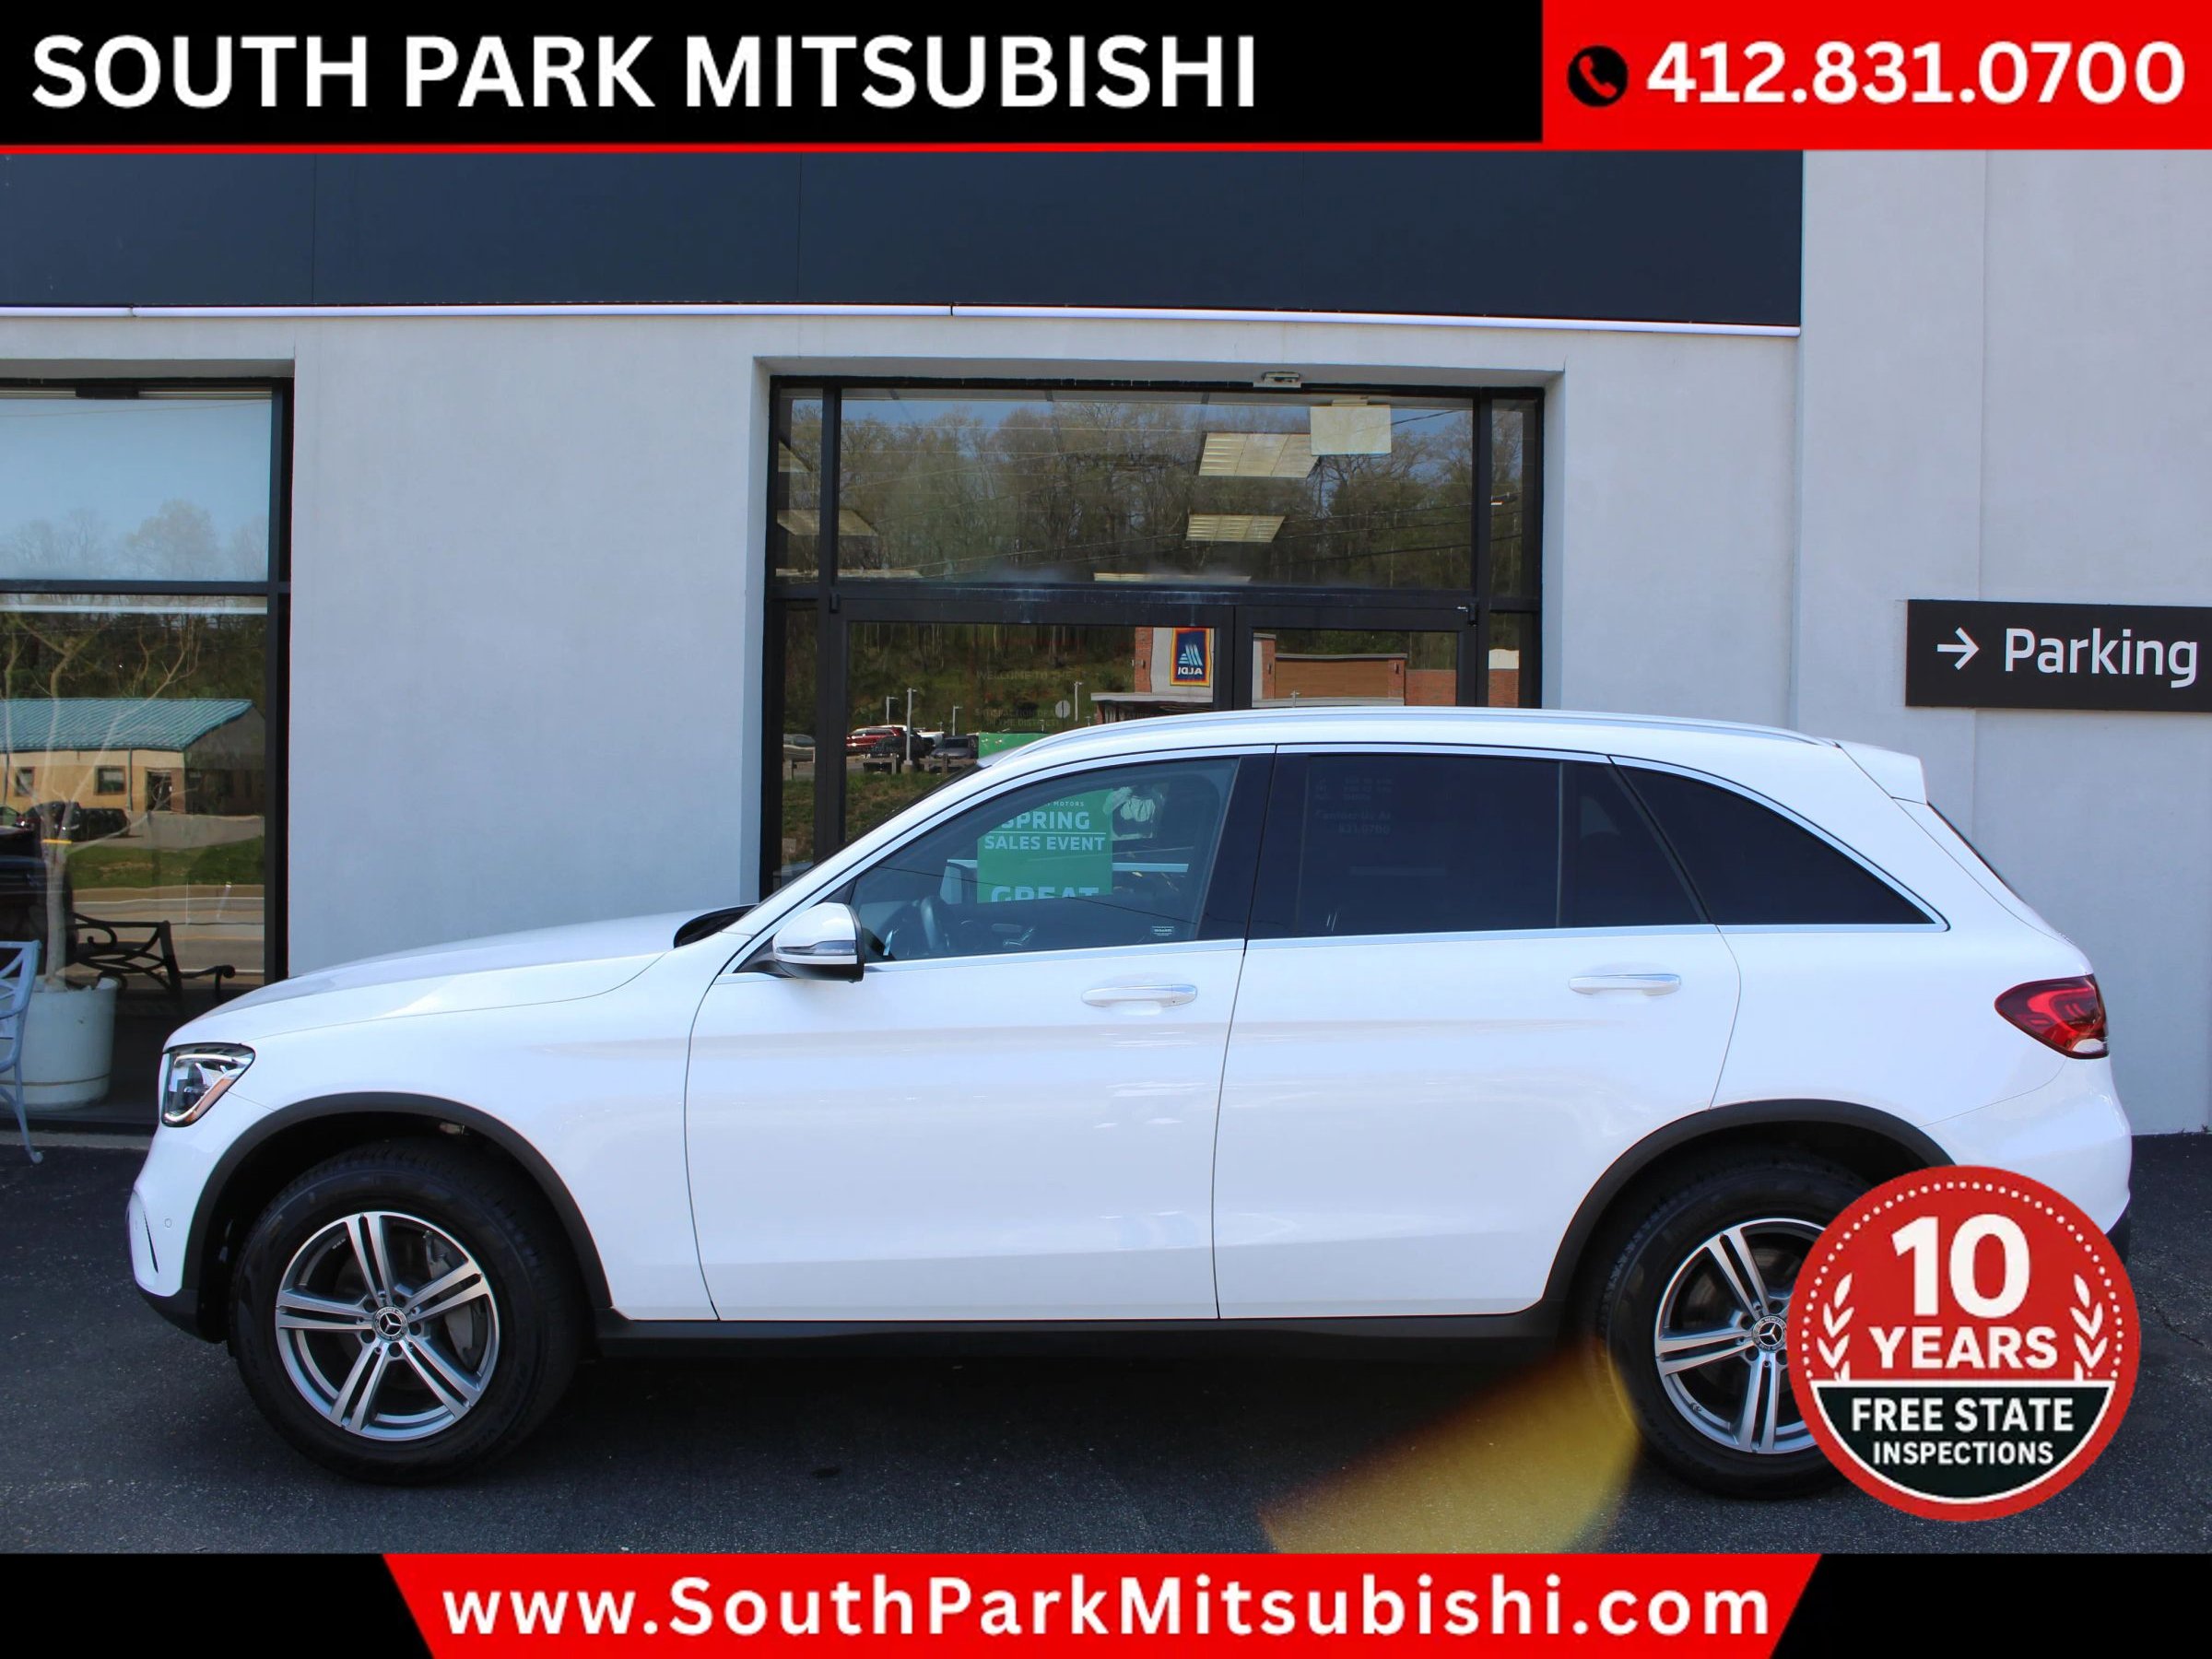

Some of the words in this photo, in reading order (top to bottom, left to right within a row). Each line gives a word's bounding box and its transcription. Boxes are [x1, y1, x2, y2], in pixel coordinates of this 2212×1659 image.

[2005, 628, 2198, 688] Parking
[1001, 810, 1091, 830] SPRING
[983, 834, 1041, 851] SALES
[1046, 835, 1106, 852] EVENT
